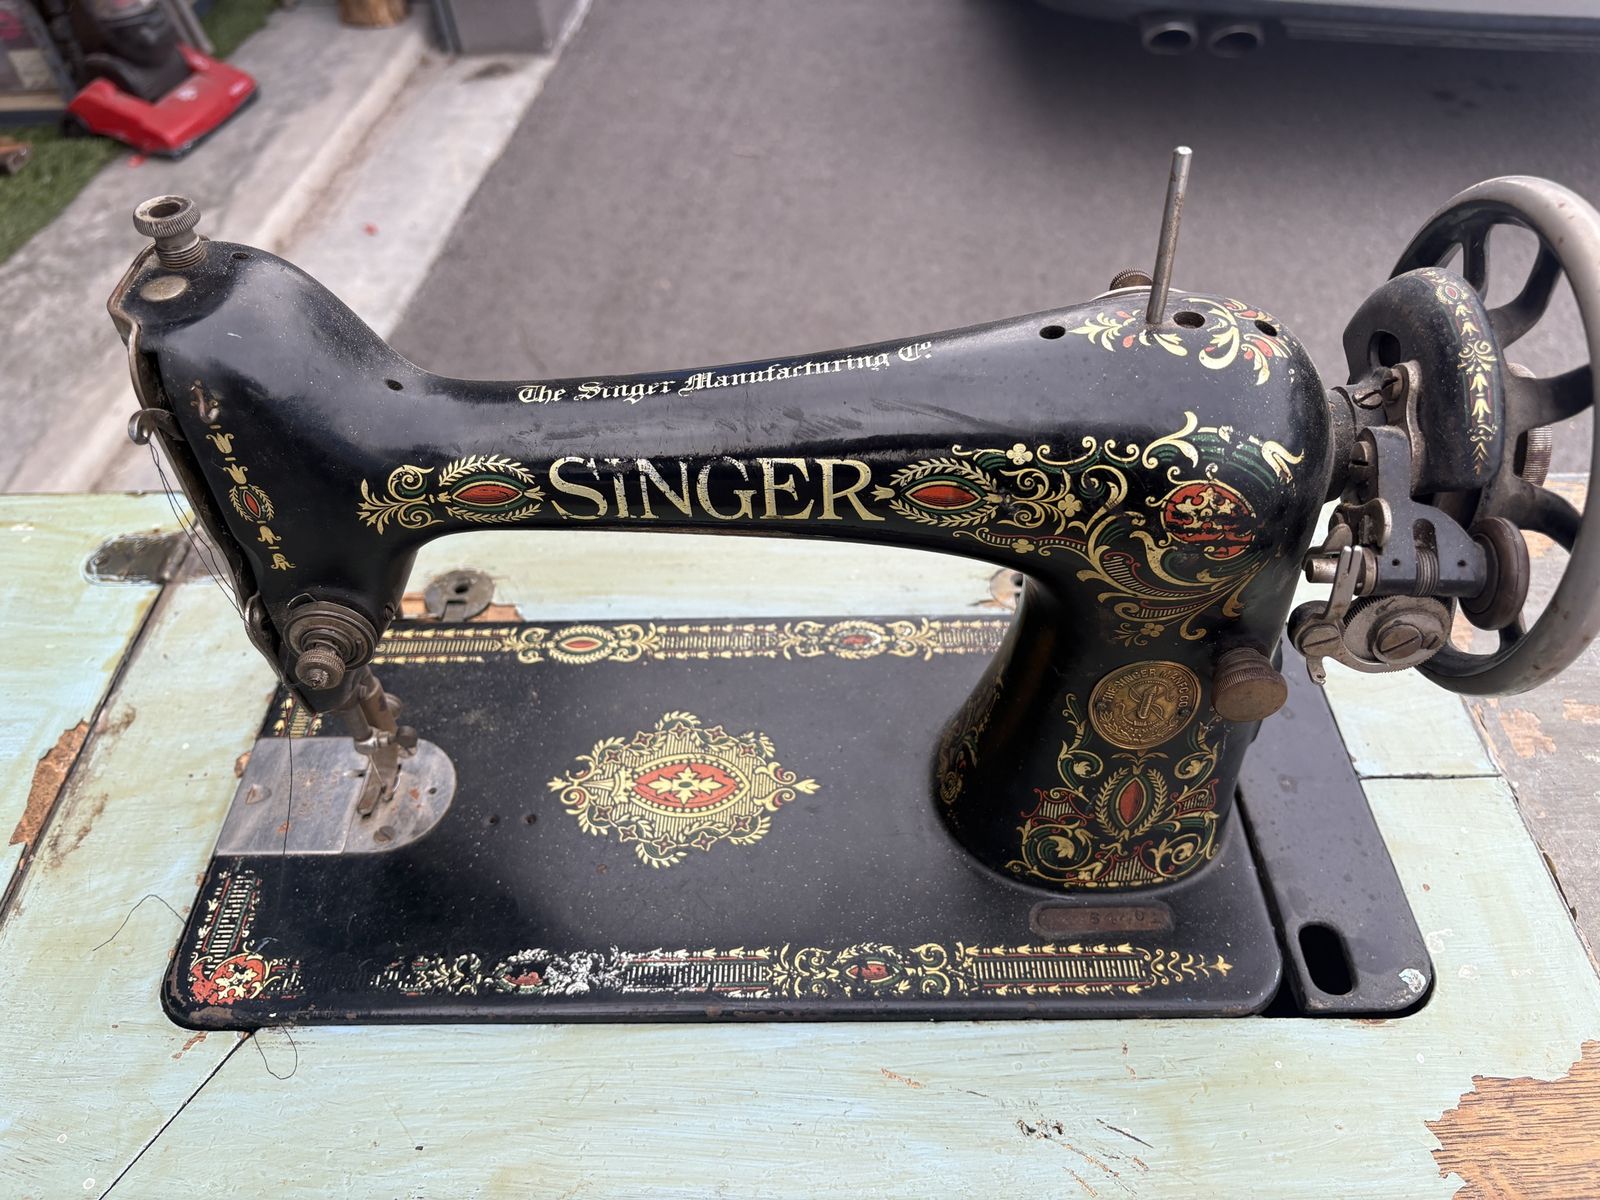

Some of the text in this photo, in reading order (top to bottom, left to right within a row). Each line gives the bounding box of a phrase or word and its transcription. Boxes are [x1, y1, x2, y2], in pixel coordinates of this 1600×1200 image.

[518, 384, 566, 404] The
[573, 380, 675, 405] Singer
[680, 360, 889, 397] Manufacturing
[549, 456, 886, 521] SINGER
